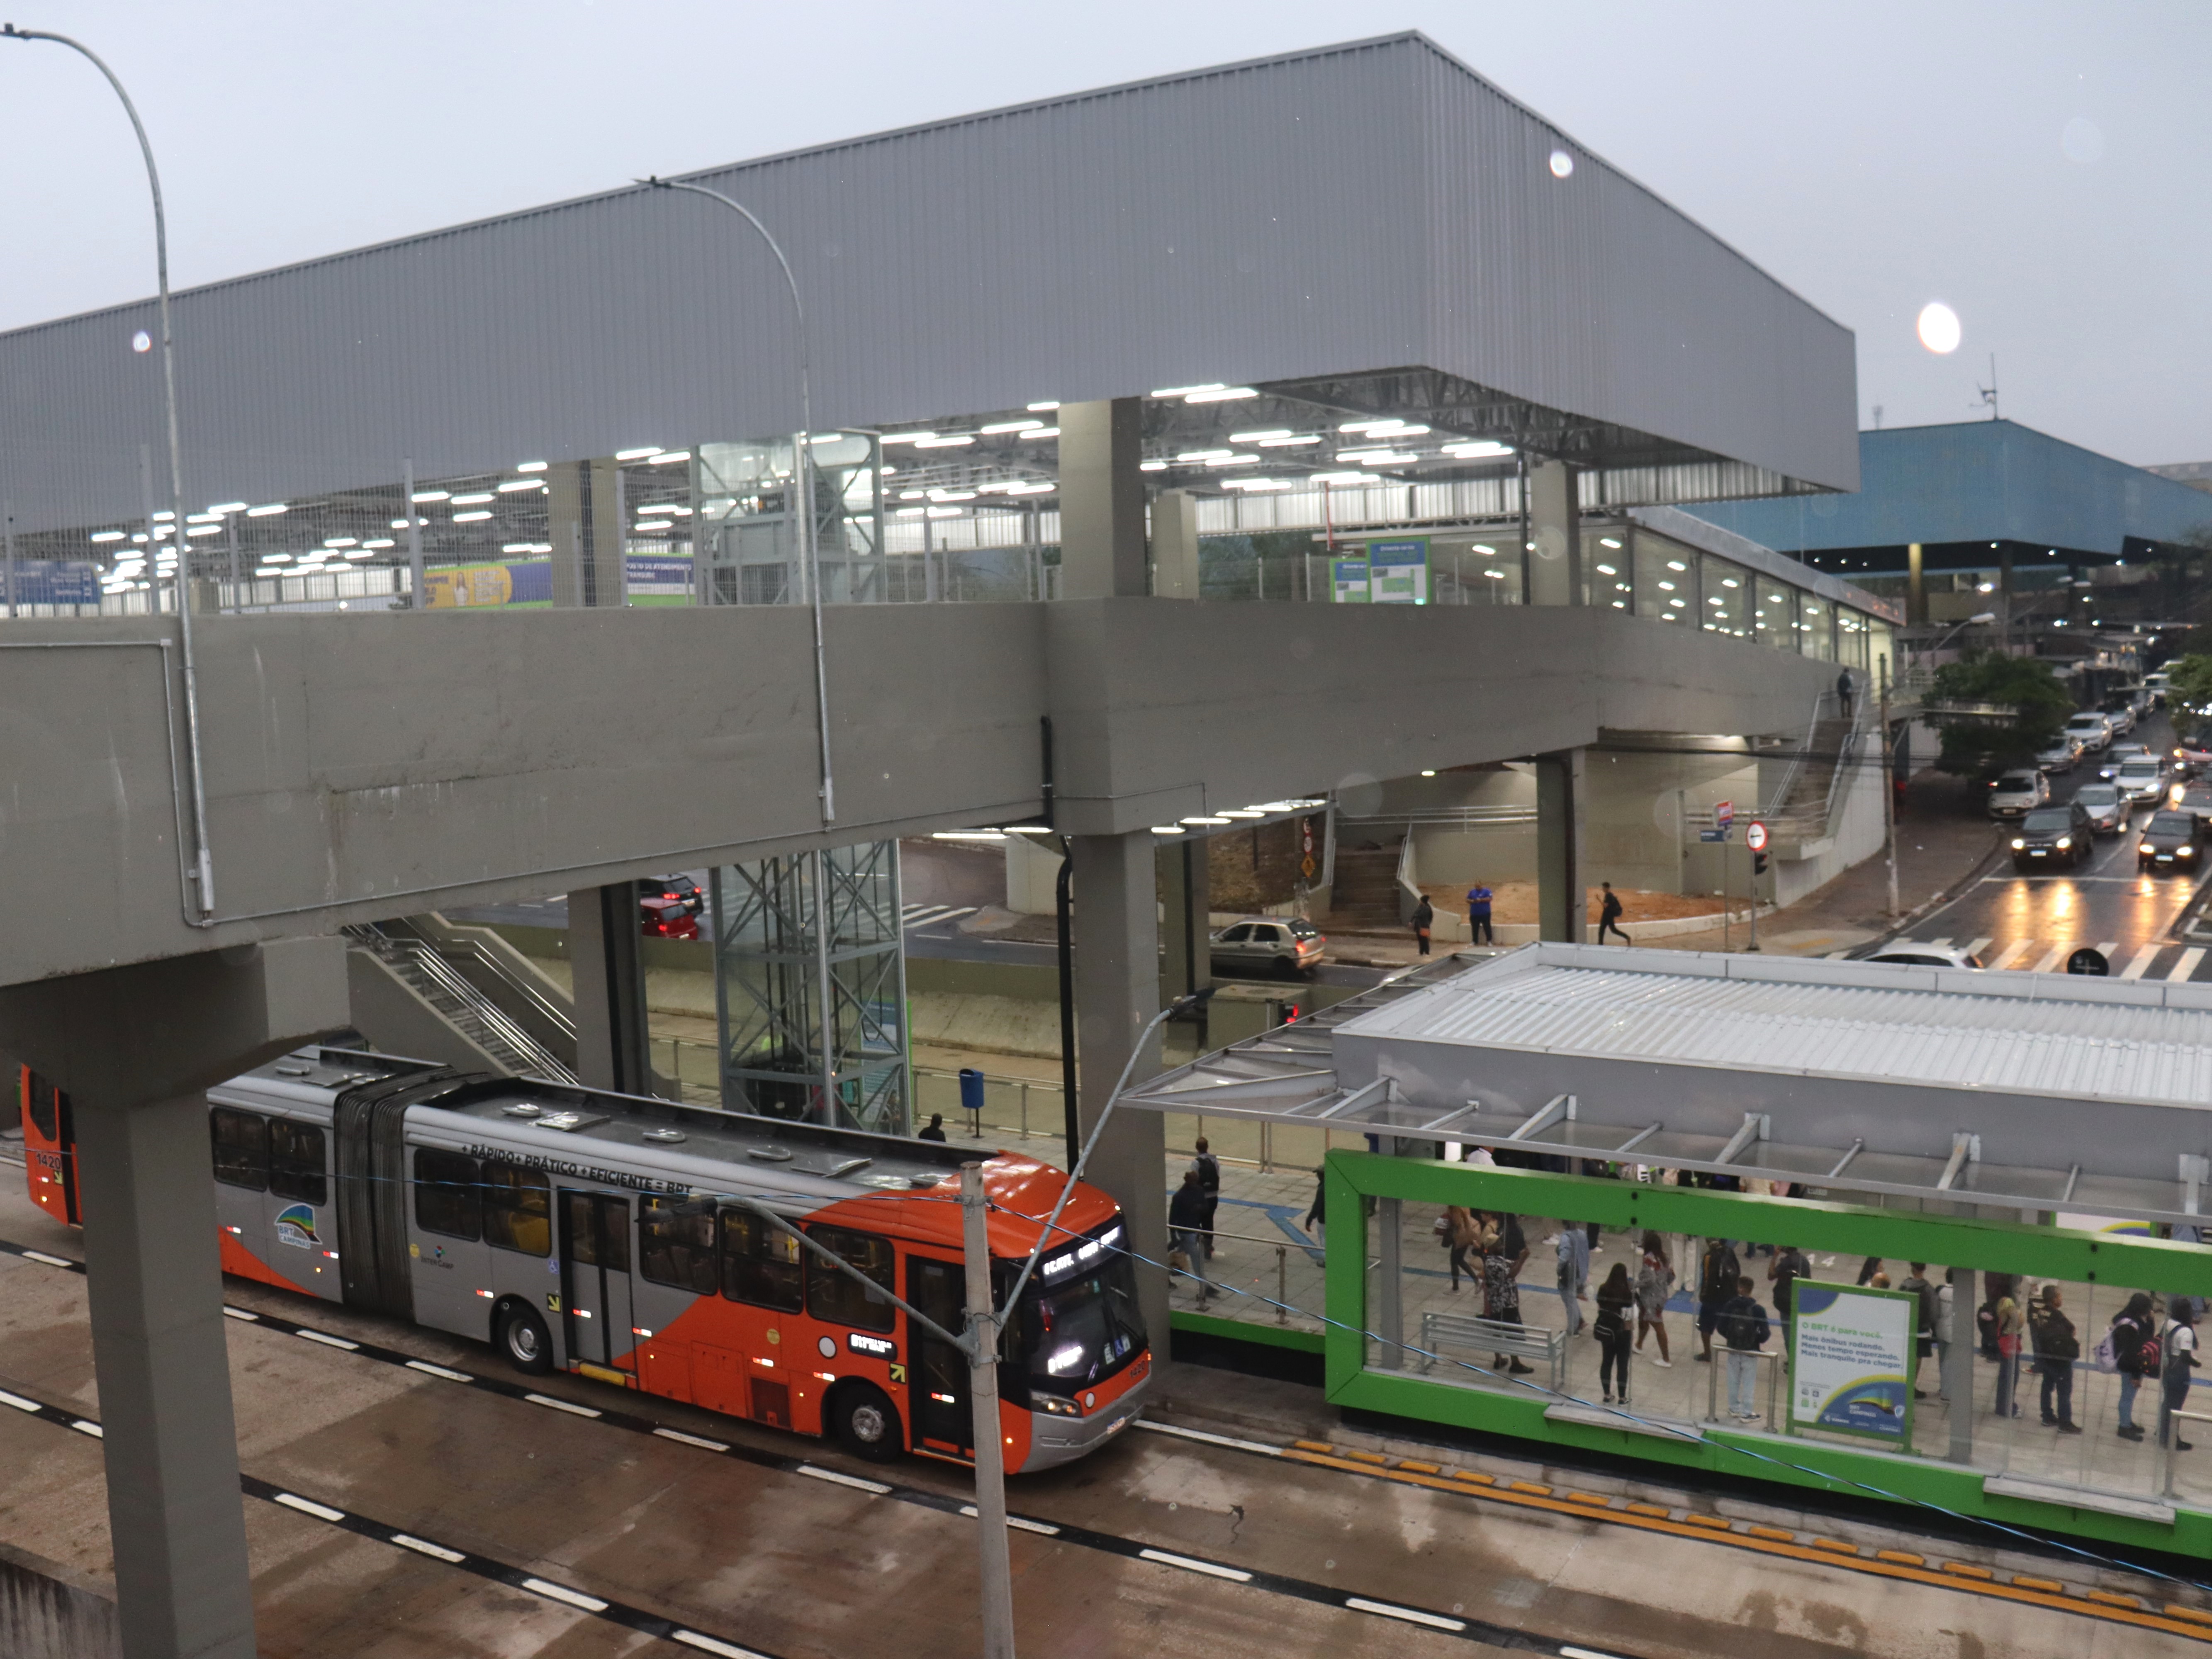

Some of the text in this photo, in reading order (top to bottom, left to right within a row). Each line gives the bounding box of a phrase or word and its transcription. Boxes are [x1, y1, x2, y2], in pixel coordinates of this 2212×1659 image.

[37, 1153, 61, 1169] 1420
[471, 1144, 514, 1162] RÁPIDO
[525, 1154, 577, 1175] PRÁTICO
[589, 1167, 653, 1190] EFICIENTE
[279, 1226, 293, 1236] BRT
[1801, 1342, 1900, 1361] Menos tempo esperando.
[1821, 1337, 1847, 1346] ônibus
[1849, 1341, 1885, 1351] rodando.
[1801, 1349, 1818, 1357] Mais
[1820, 1352, 1856, 1363] tranquilo
